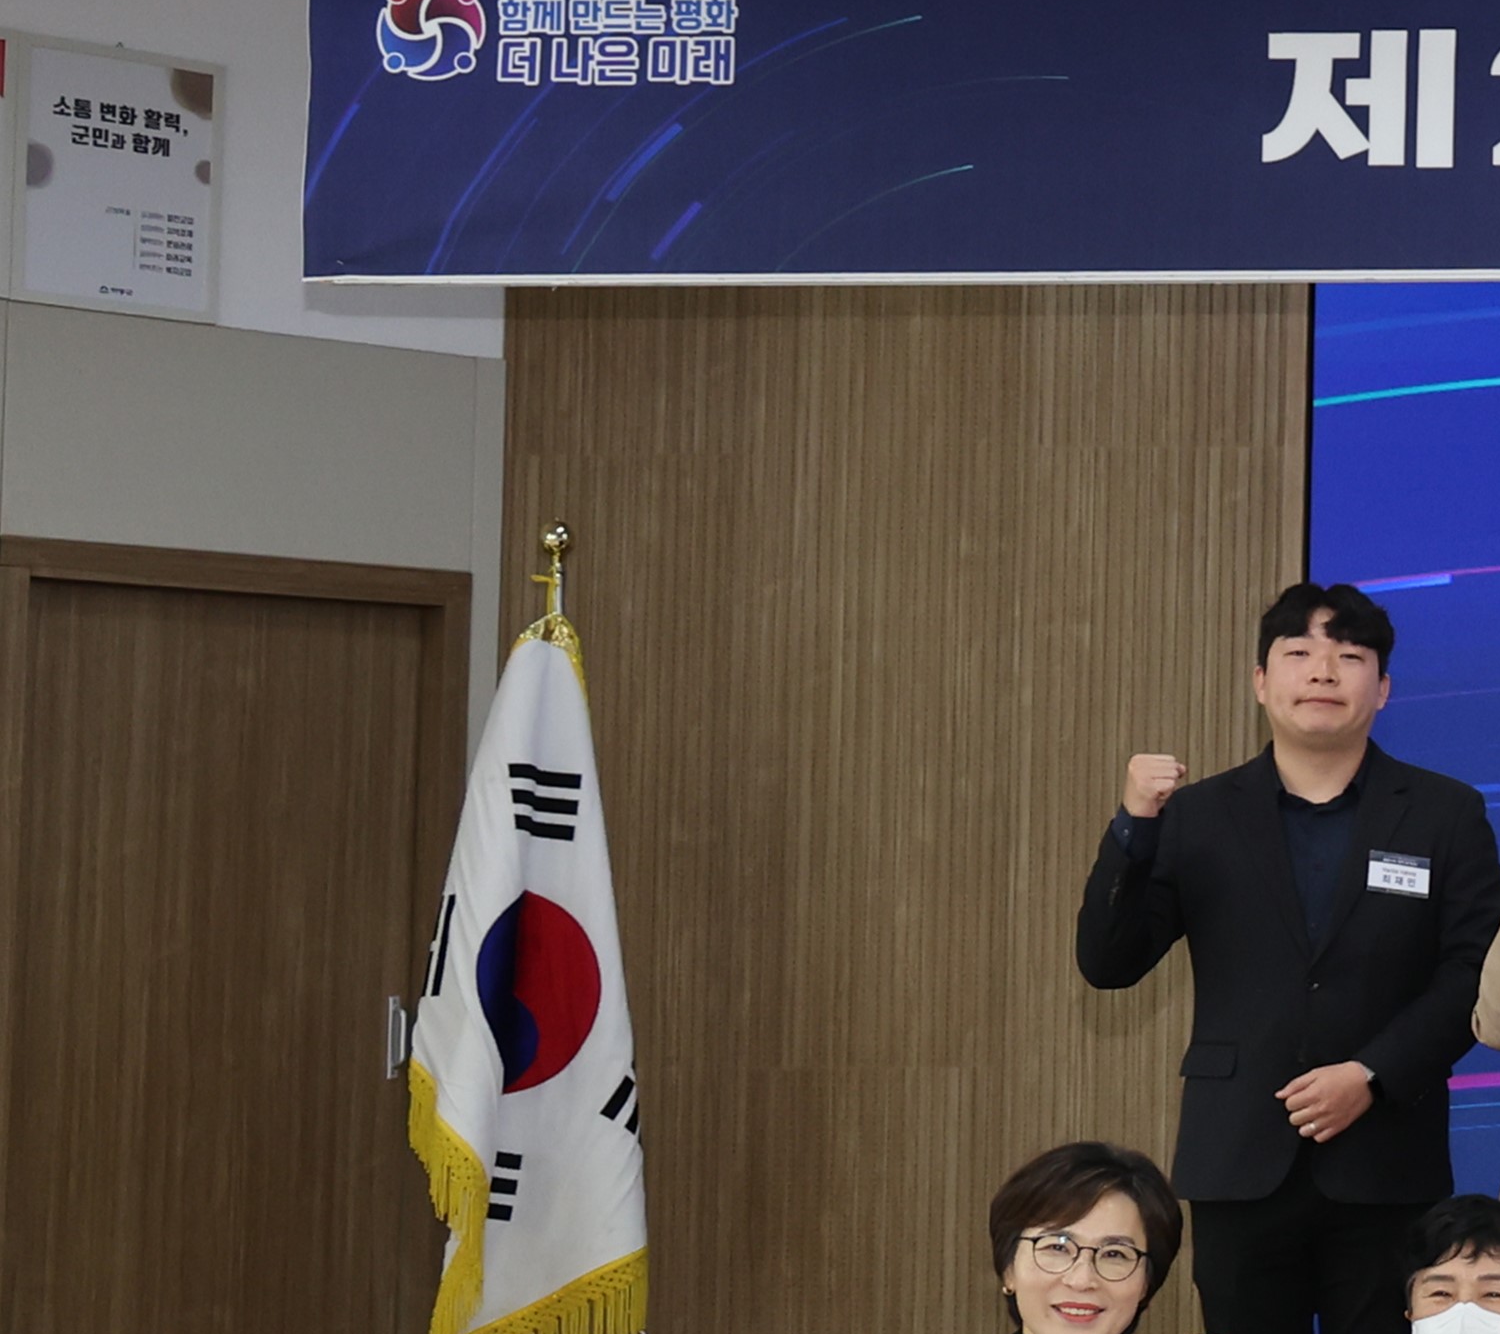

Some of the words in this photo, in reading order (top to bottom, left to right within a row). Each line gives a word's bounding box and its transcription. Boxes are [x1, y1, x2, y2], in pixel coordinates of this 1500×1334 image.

[496, 37, 541, 85] 더
[550, 36, 639, 85] 나은
[647, 36, 735, 85] 미래
[52, 95, 92, 120] 소통
[99, 101, 138, 126] 변화
[70, 124, 127, 150] 군민과
[131, 132, 171, 158] 함께
